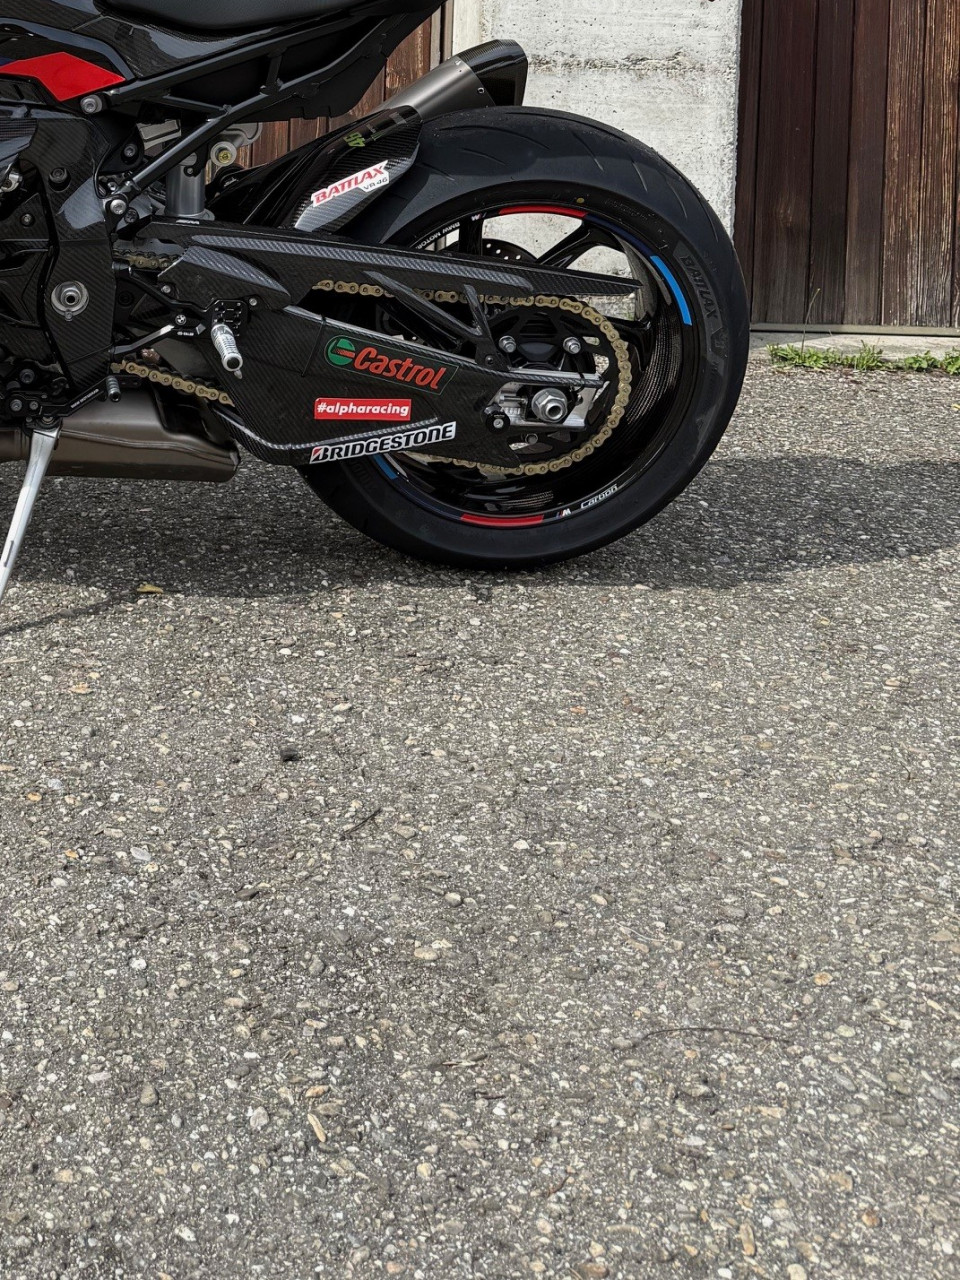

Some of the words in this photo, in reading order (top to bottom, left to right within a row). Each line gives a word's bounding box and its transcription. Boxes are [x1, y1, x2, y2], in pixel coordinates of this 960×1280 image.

[314, 165, 386, 204] BATTLAX
[354, 347, 446, 390] Castrol
[317, 402, 410, 417] #alpharacing
[311, 423, 454, 462] BRIDGESTONE
